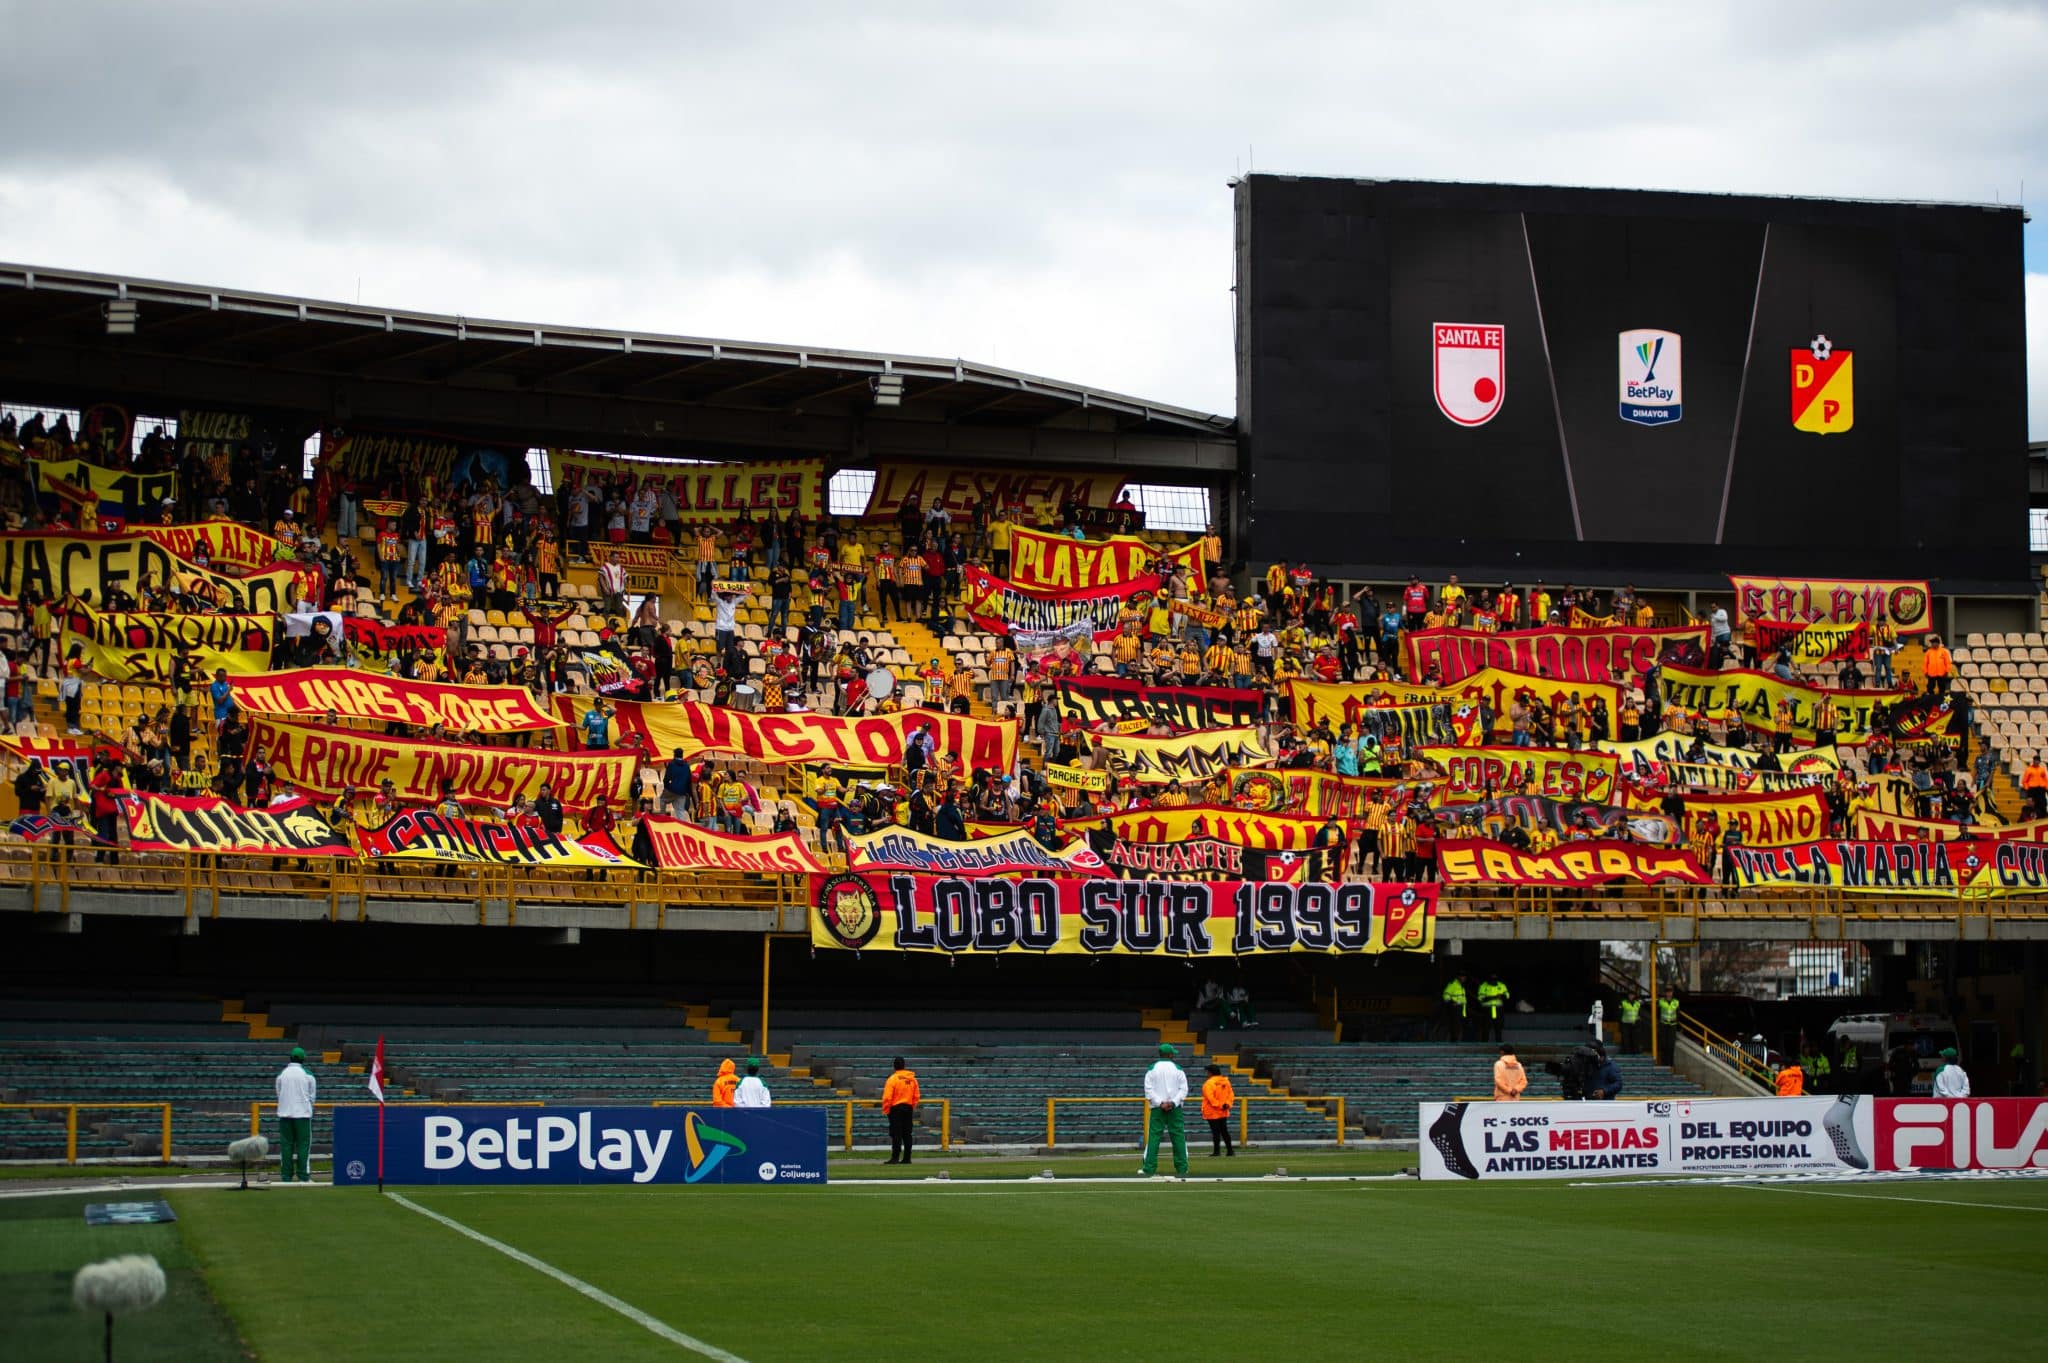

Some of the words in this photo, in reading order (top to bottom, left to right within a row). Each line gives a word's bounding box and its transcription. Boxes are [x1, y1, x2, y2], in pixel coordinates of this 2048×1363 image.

[1438, 328, 1481, 346] SANTA
[1484, 330, 1500, 347] FE
[1627, 385, 1674, 401] BetPlay
[1632, 409, 1669, 418] DIMAYOR
[220, 527, 275, 567] ALTA
[592, 547, 668, 568] VESALLES
[1015, 535, 1120, 588] PLAYA
[1001, 588, 1058, 631] ETERNO
[1664, 677, 1775, 718] VILLA
[682, 701, 1004, 778] VICTORIA
[253, 723, 399, 790] PARQUE
[404, 749, 627, 809] INDUSTRIAL
[1048, 768, 1080, 784] PARCHE
[1449, 755, 1583, 797] CORALES
[149, 797, 300, 851] CUBA
[867, 834, 930, 870] LOS
[1110, 839, 1243, 876] AGUANTE
[1734, 845, 1832, 886] VILLA
[1838, 843, 1954, 888] MARIA
[891, 876, 1060, 950] LOBO
[1080, 878, 1213, 955] SUR
[1234, 881, 1375, 951] 1999
[1483, 1117, 1498, 1128] FC
[1510, 1116, 1549, 1127] SOCKS
[1484, 1130, 1540, 1153] LAS
[1549, 1126, 1659, 1152] MEDIAS
[1681, 1122, 1722, 1139] DEL
[1730, 1120, 1812, 1141] EQUIPO
[423, 1111, 673, 1183] BetPlay
[1485, 1153, 1659, 1173] ANTIDESLIZANTES
[1681, 1143, 1812, 1161] PROFESIONAL
[780, 1170, 820, 1179] Coljuegos
